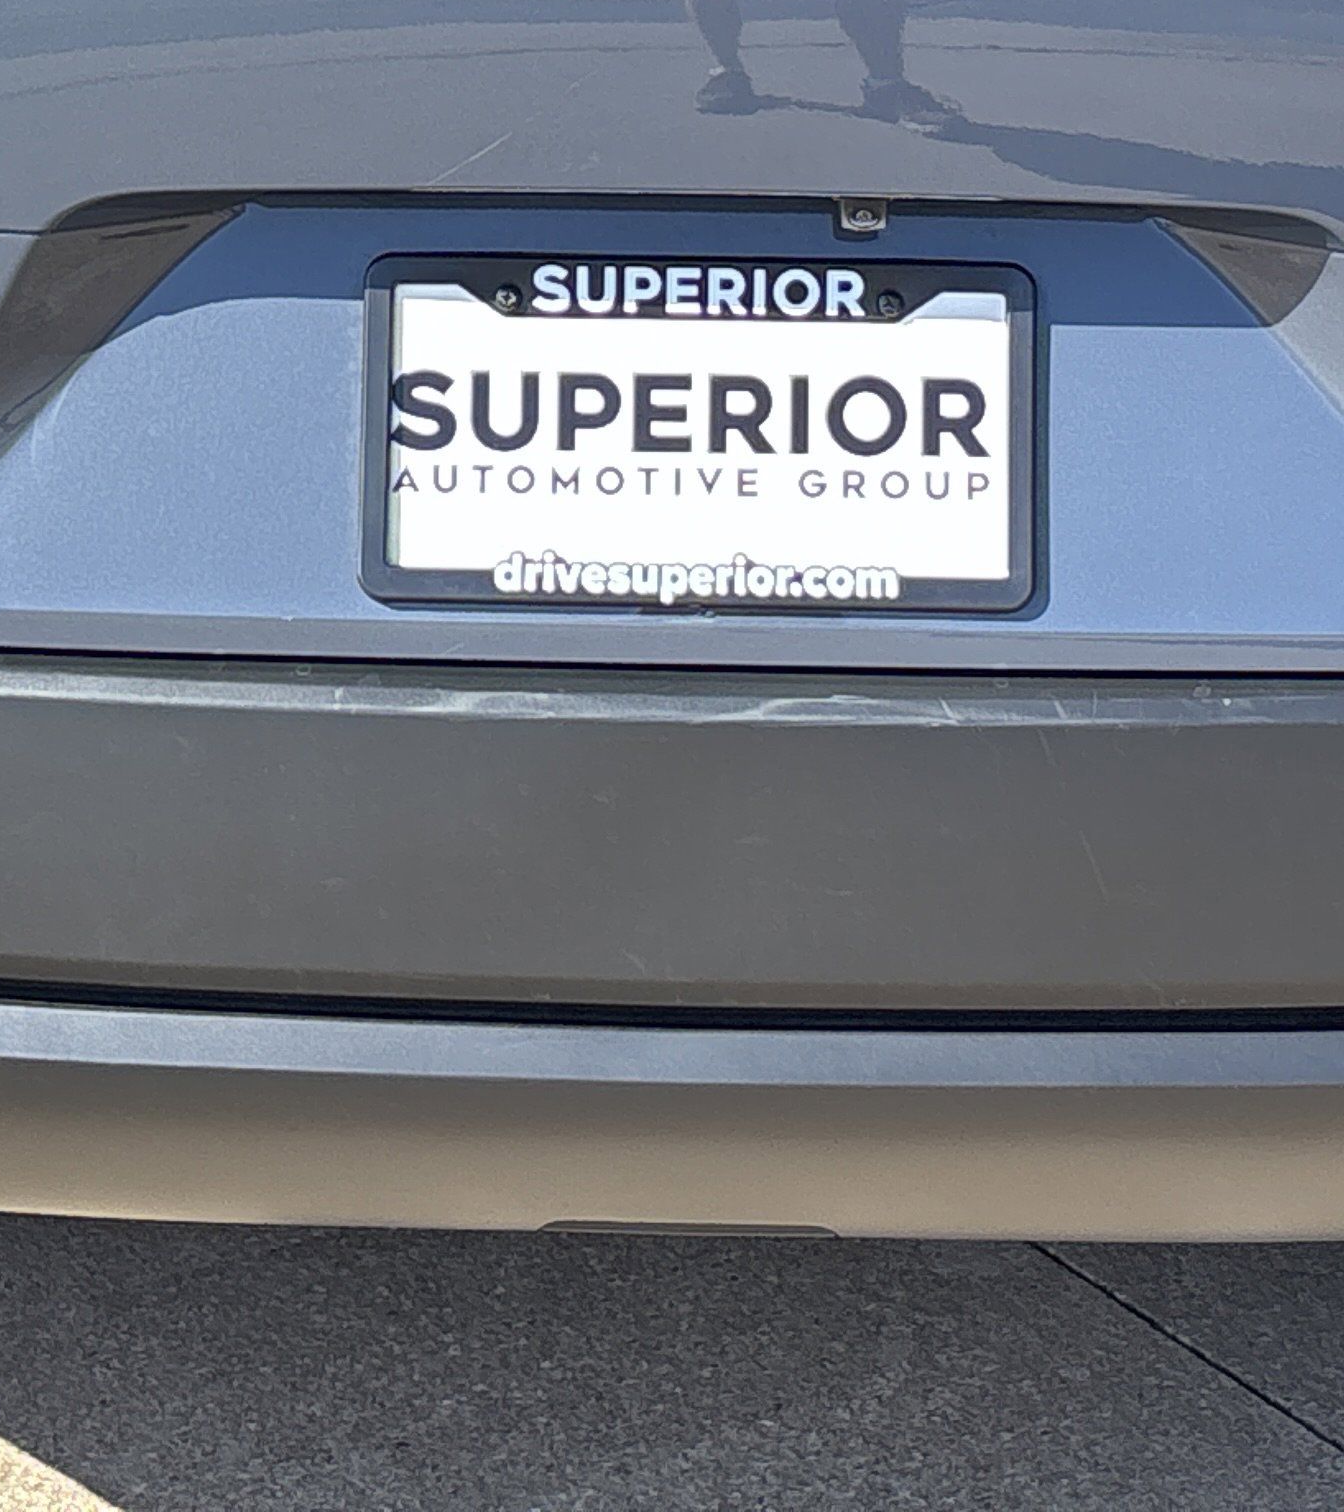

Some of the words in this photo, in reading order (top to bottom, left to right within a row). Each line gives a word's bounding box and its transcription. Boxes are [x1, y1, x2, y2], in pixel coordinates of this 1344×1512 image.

[531, 263, 866, 317] SUPERIOR
[390, 369, 992, 458] SUPERIOR
[392, 464, 759, 499] AUTOMOTIVE
[798, 468, 991, 502] GROUP
[493, 548, 899, 606] drivesuperior.com
